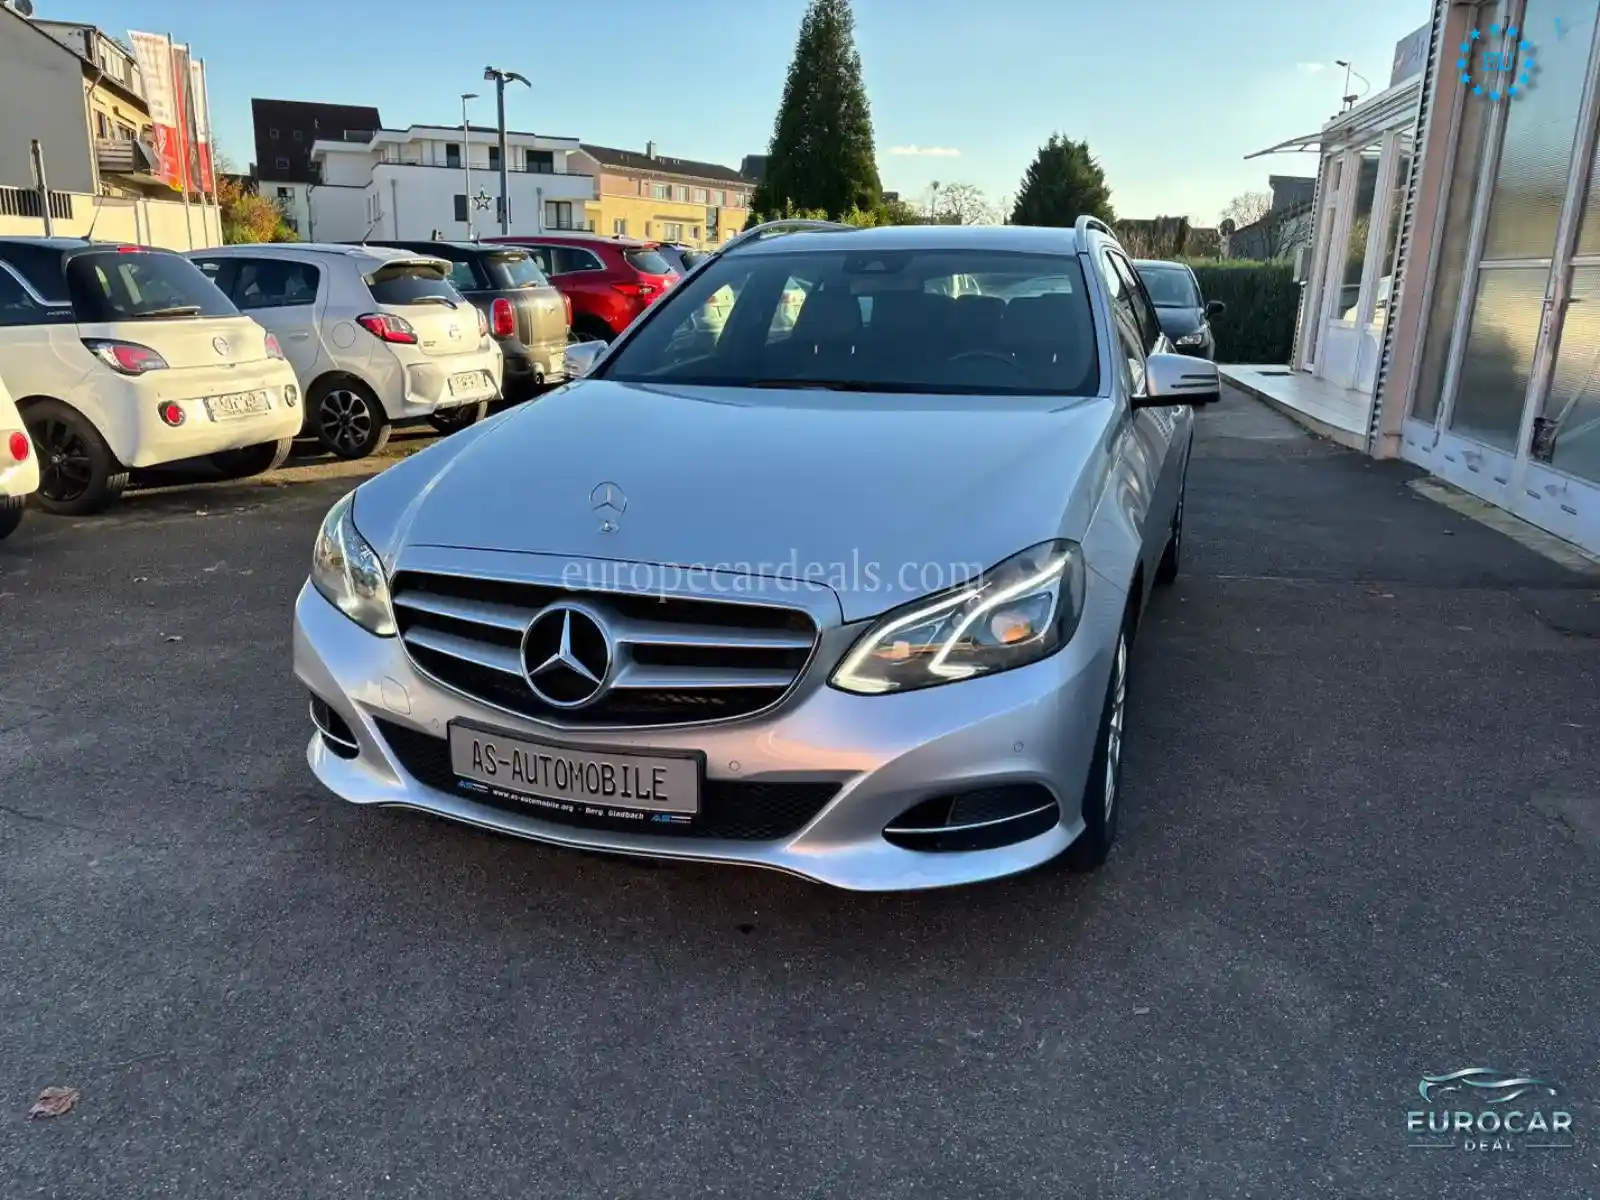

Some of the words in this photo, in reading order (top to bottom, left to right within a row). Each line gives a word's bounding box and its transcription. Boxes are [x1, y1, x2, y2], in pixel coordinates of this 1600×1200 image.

[472, 740, 668, 801] AS-AUTOMOBILE
[492, 788, 574, 813] www.as-automobile.org
[608, 809, 644, 820] Gladbach
